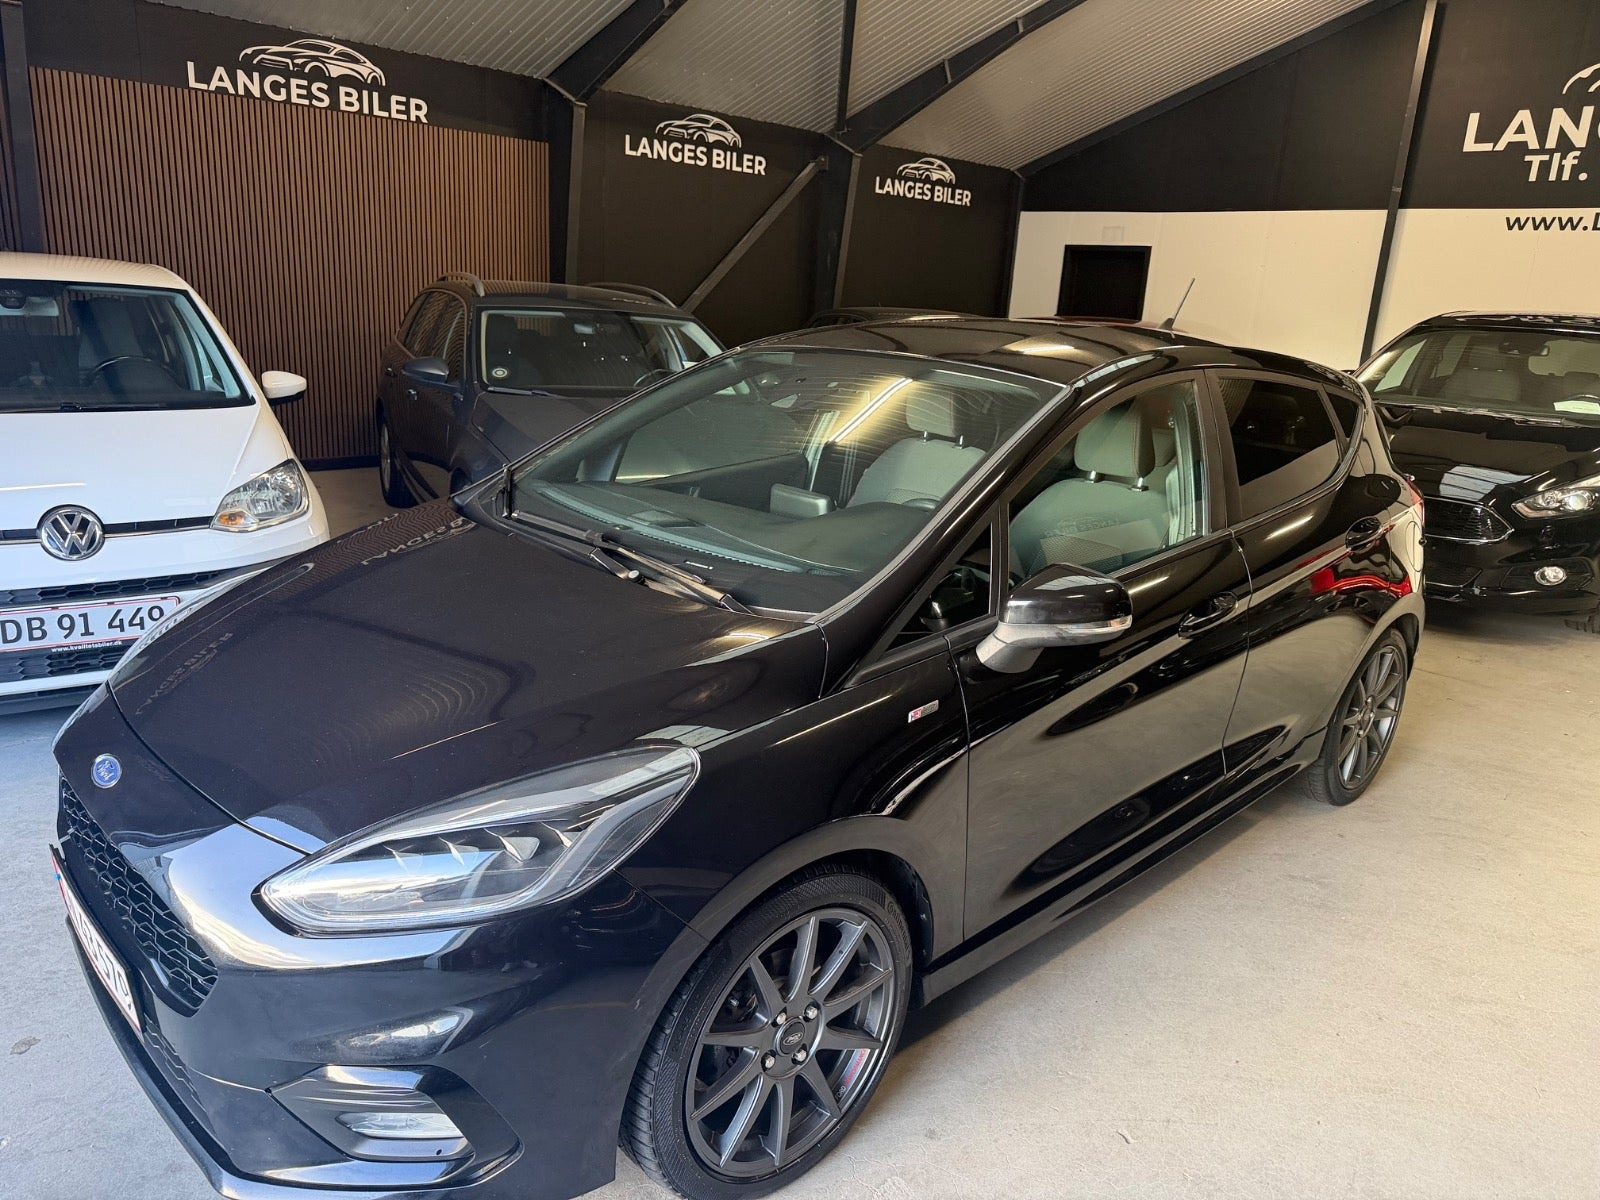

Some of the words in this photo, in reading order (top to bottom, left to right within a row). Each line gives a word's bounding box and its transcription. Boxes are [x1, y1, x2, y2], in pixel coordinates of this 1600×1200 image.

[188, 60, 329, 107] LANGES
[339, 85, 428, 123] BILER
[1463, 105, 1600, 152] LAN
[624, 134, 708, 167] LANGES
[711, 148, 766, 175] BILER
[1524, 151, 1588, 182] Tlf.
[875, 176, 931, 201] LANGES
[933, 185, 972, 207] BILER
[0, 616, 48, 645] DB
[56, 612, 95, 640] 91
